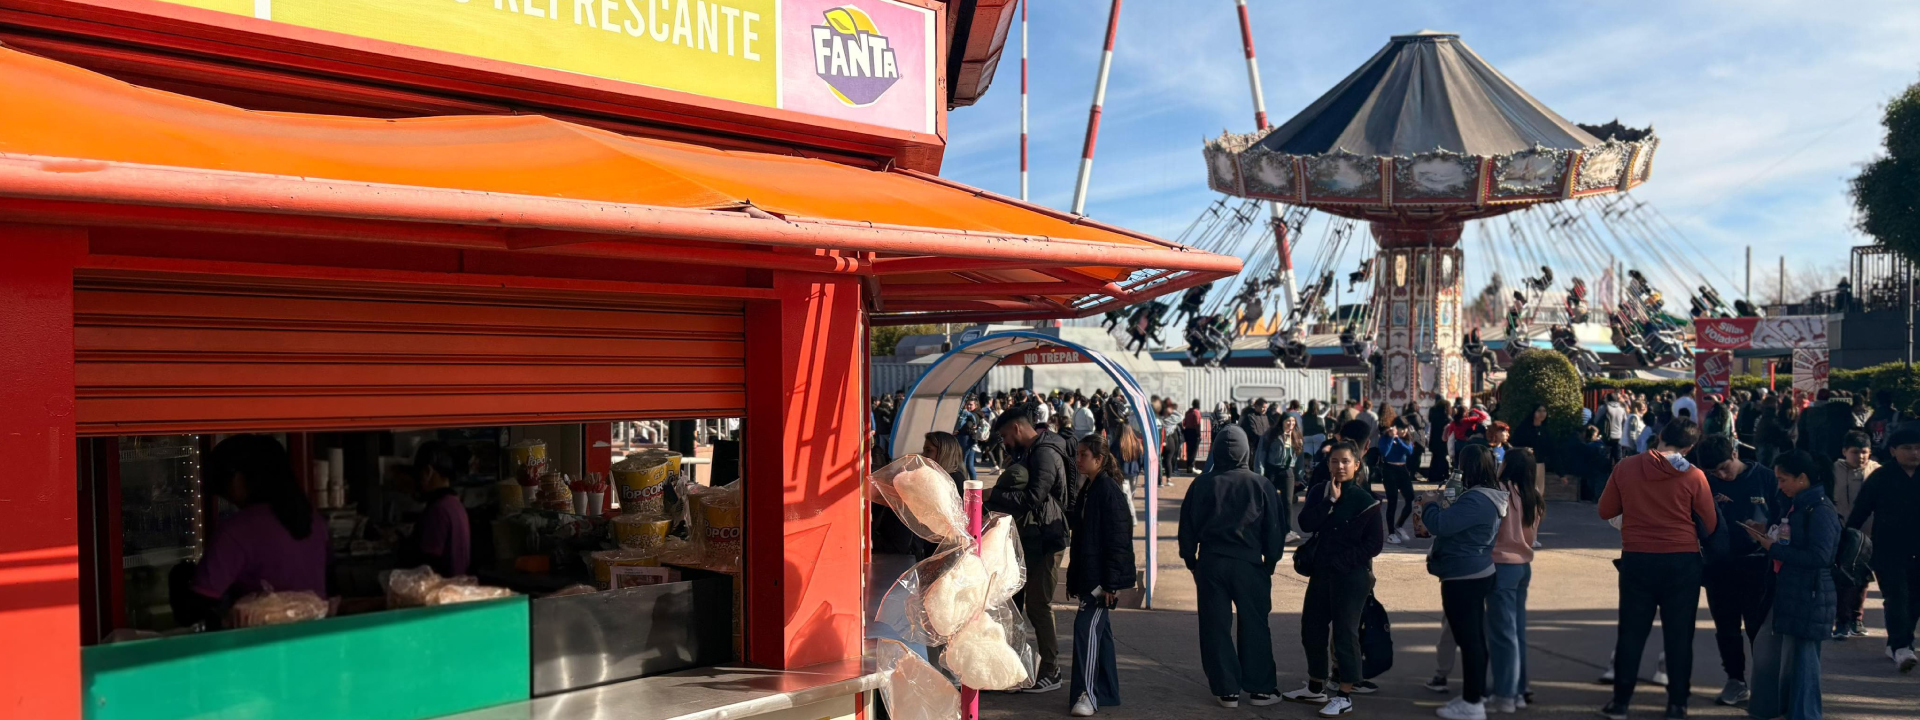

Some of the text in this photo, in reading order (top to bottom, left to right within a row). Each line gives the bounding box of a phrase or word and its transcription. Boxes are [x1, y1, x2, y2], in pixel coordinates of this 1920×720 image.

[813, 28, 898, 78] FANTA
[1718, 321, 1745, 334] Sillas
[1024, 351, 1080, 363] NO TREPAR
